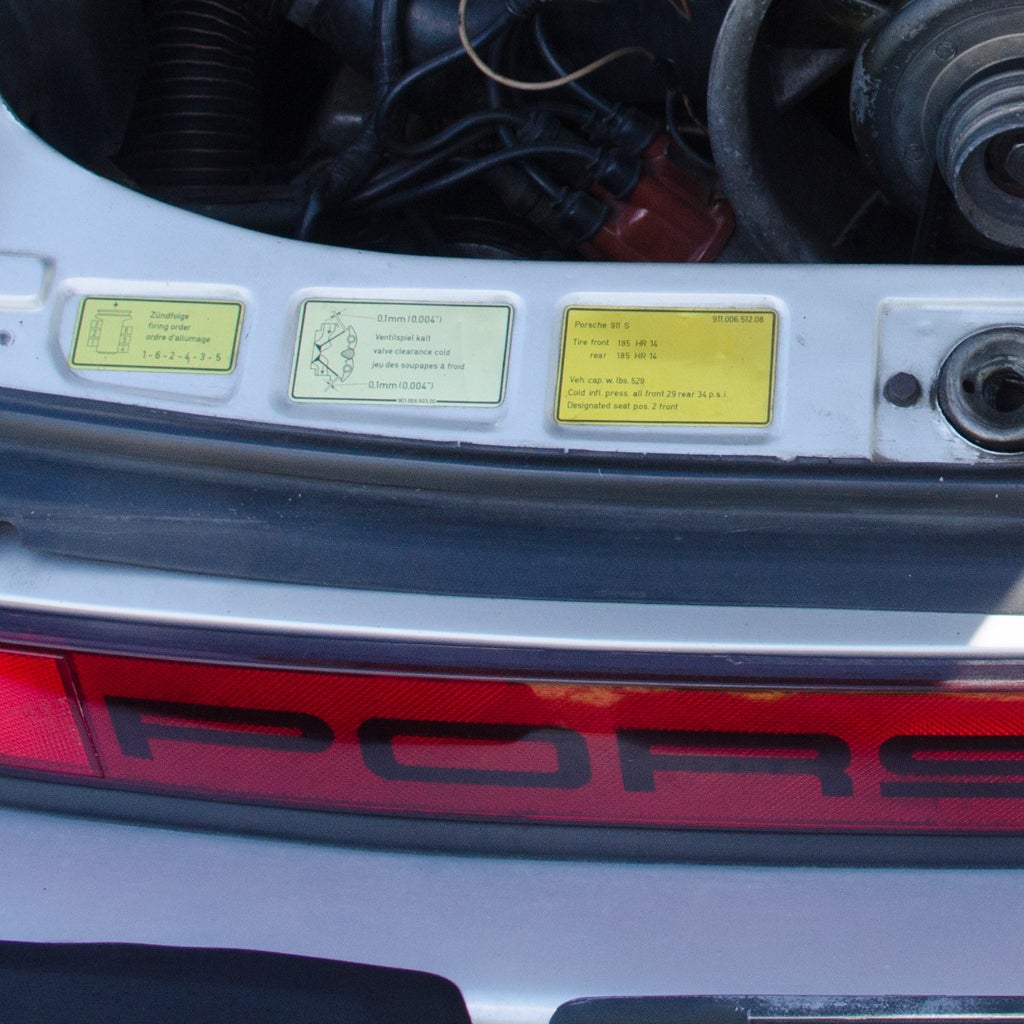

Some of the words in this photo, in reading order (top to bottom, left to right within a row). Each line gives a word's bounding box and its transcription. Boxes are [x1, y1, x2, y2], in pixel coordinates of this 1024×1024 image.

[150, 311, 189, 321] Zündfolge
[148, 322, 169, 331] firing
[170, 323, 191, 331] order
[574, 321, 607, 329] Porsche
[168, 334, 211, 344] d'allumage
[376, 334, 414, 342] Ventilspiel
[573, 338, 587, 346] Tire
[591, 338, 609, 346] front
[618, 339, 631, 347] 185
[635, 339, 647, 347] HR
[651, 339, 658, 347] 14
[371, 361, 384, 369] jeu
[401, 362, 438, 371] soupapes
[567, 388, 586, 396] Cold
[567, 401, 611, 410] Designated
